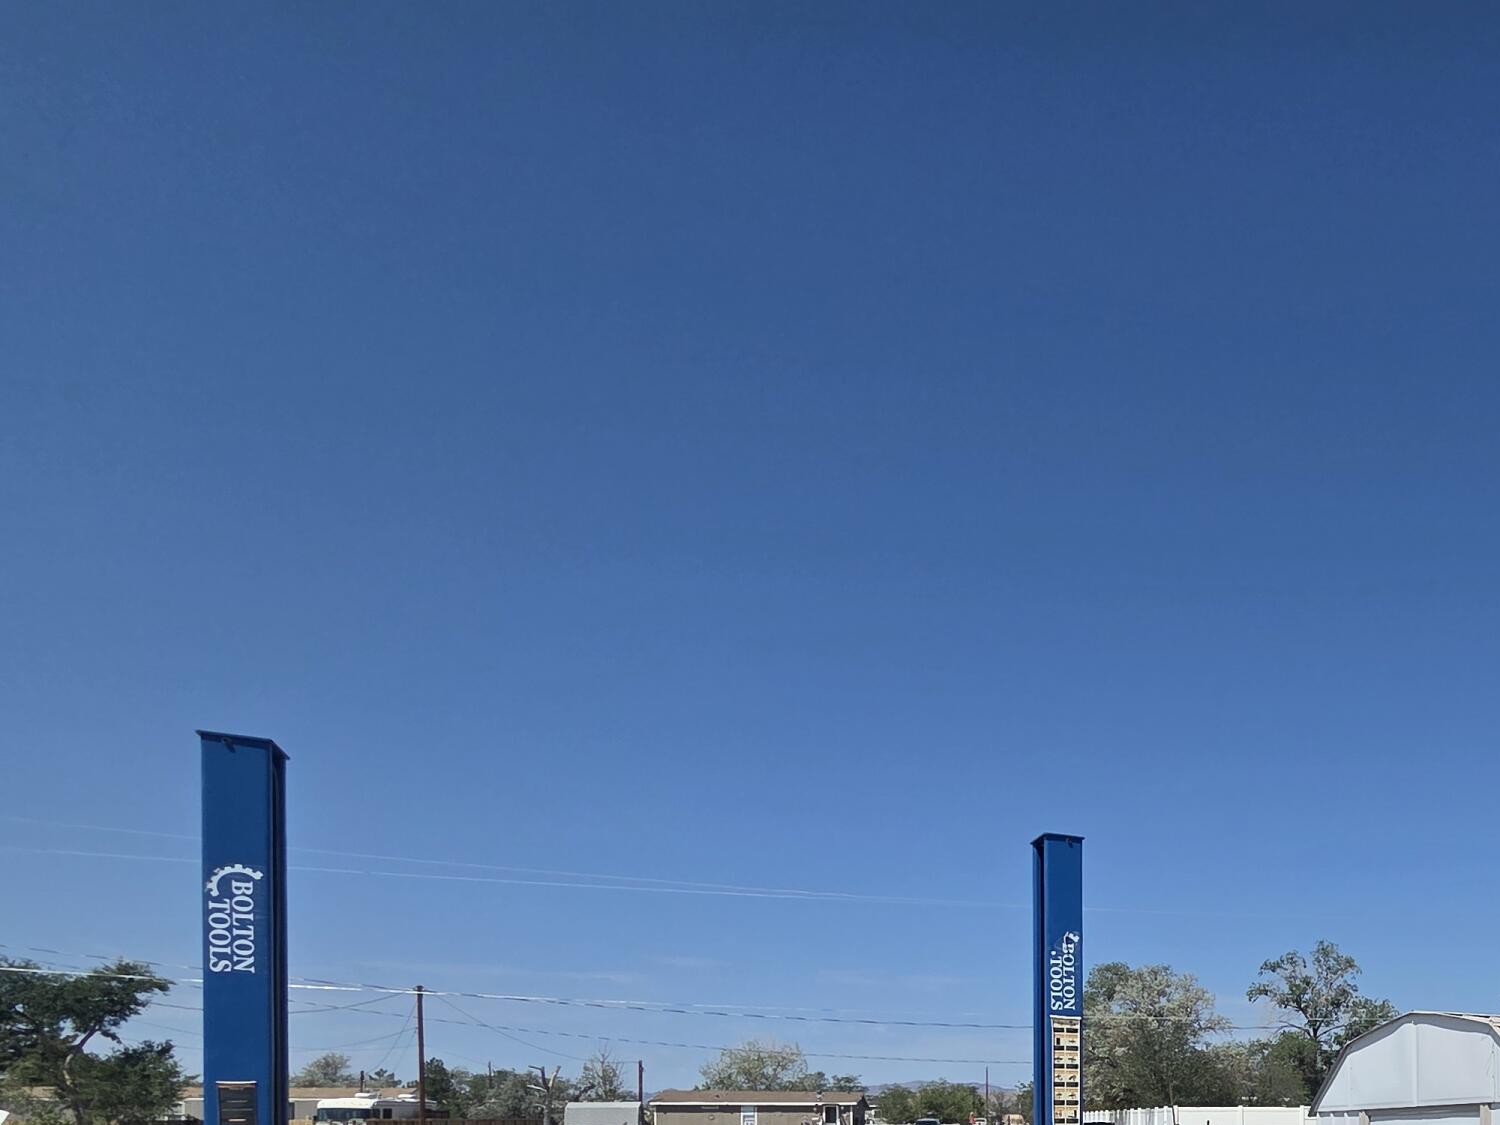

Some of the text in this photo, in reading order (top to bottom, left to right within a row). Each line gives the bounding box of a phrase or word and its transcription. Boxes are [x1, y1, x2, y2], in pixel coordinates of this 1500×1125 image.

[208, 898, 232, 972] TOOLS
[231, 880, 255, 973] BOLTON
[1050, 956, 1063, 1010] TOOLS
[1062, 942, 1076, 1010] BOLTON
